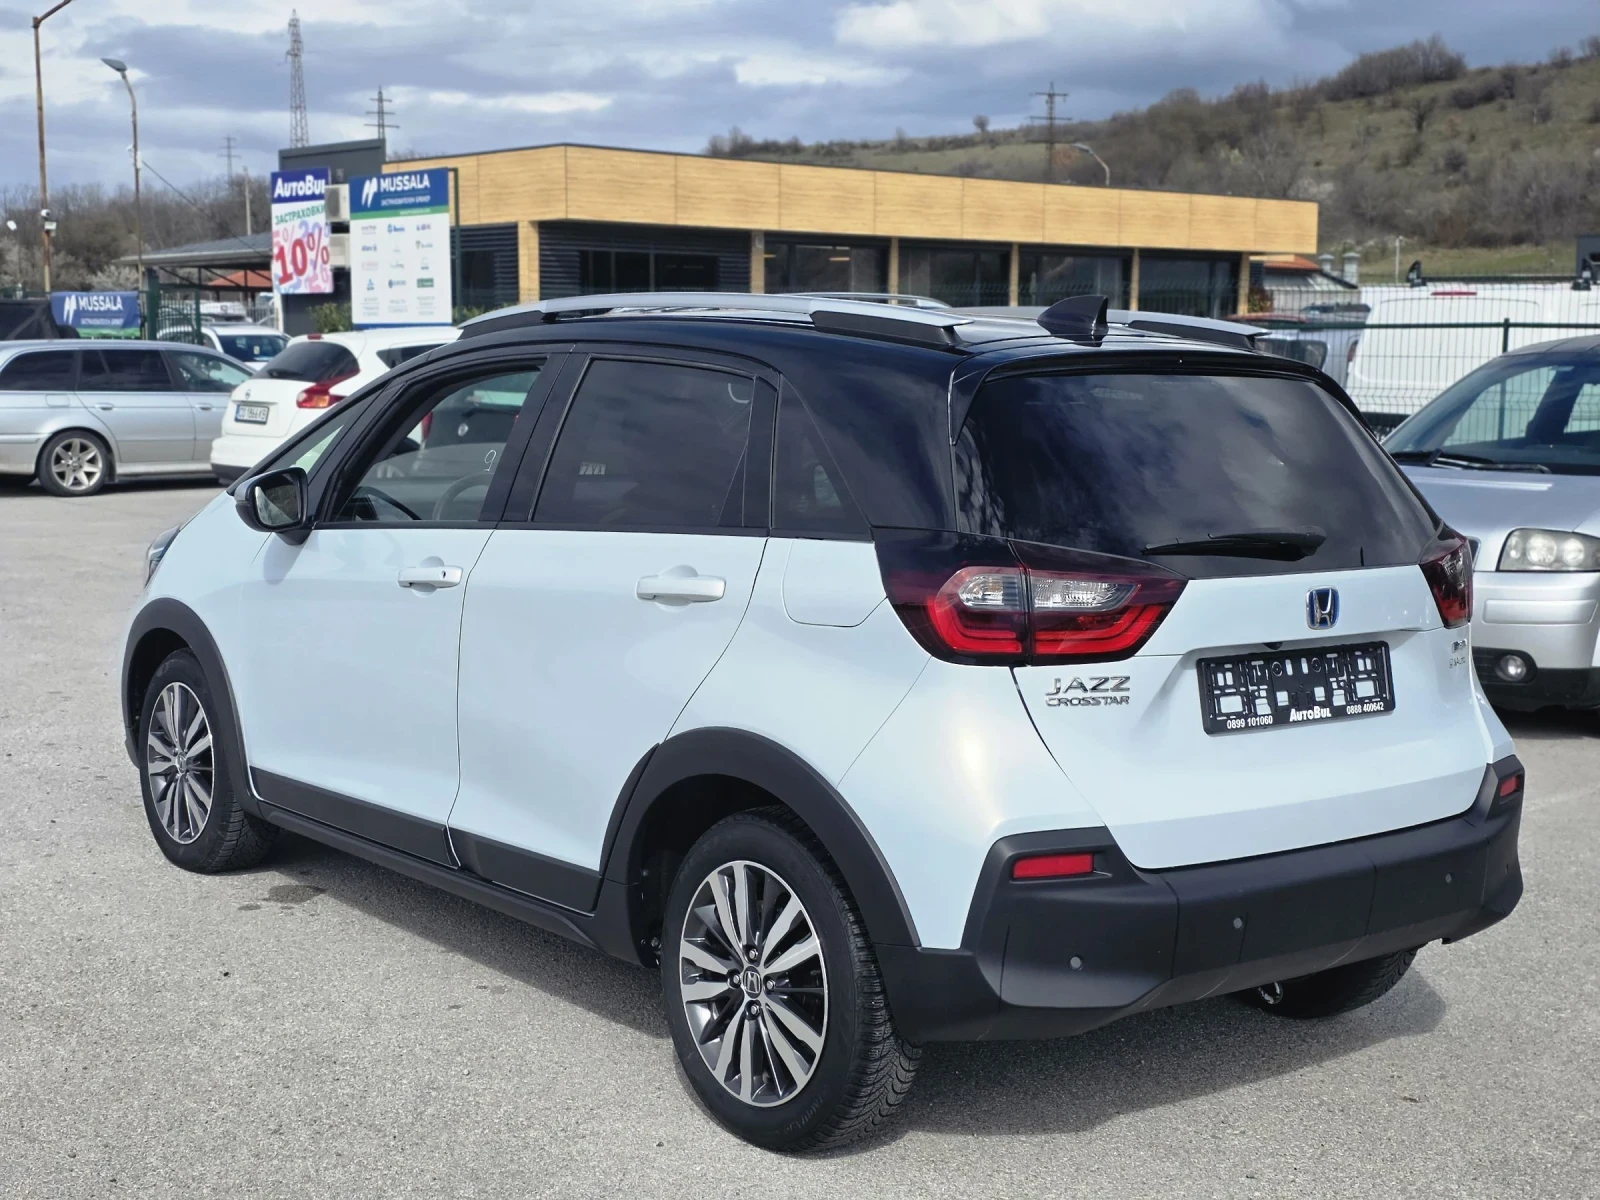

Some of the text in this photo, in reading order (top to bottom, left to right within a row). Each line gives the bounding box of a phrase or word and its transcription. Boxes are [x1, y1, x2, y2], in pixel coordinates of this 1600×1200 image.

[380, 173, 431, 193] MUSSALA
[78, 295, 124, 311] MUSSALA
[1045, 675, 1131, 696] JAZZ
[1045, 695, 1130, 707] CROSSTAR
[1346, 701, 1385, 715] 0888 400642
[1226, 715, 1273, 729] 0899 101060
